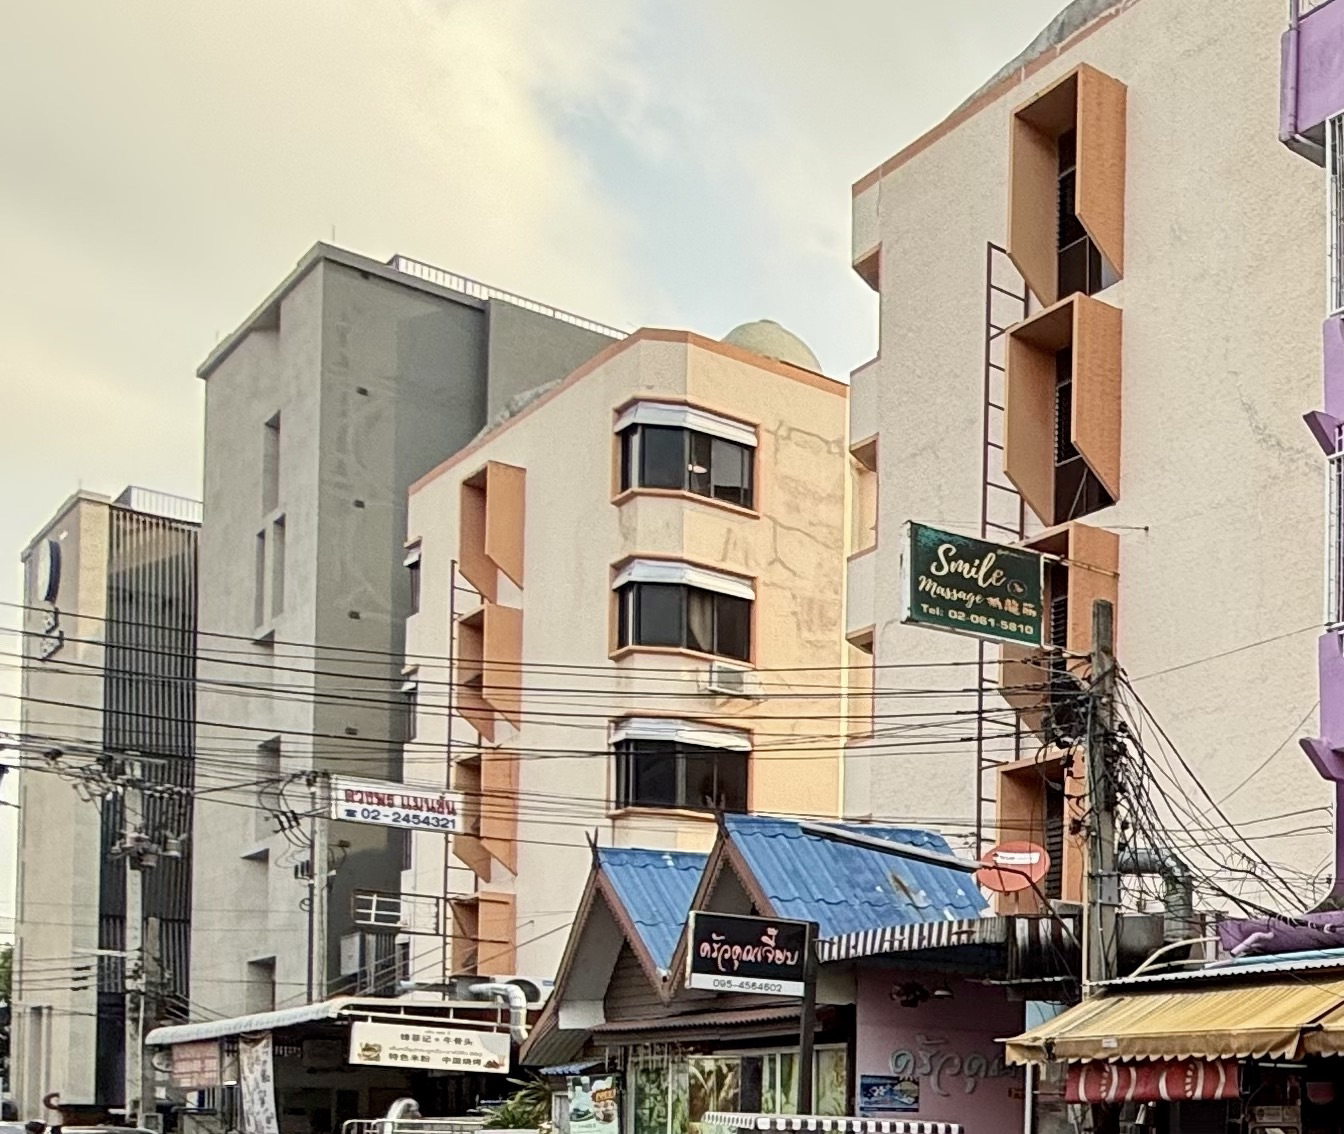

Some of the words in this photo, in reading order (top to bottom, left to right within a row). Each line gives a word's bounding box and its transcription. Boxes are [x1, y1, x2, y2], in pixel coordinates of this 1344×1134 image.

[930, 543, 1007, 588] Smile
[917, 575, 984, 609] Massage
[360, 808, 456, 829] 02-2454321
